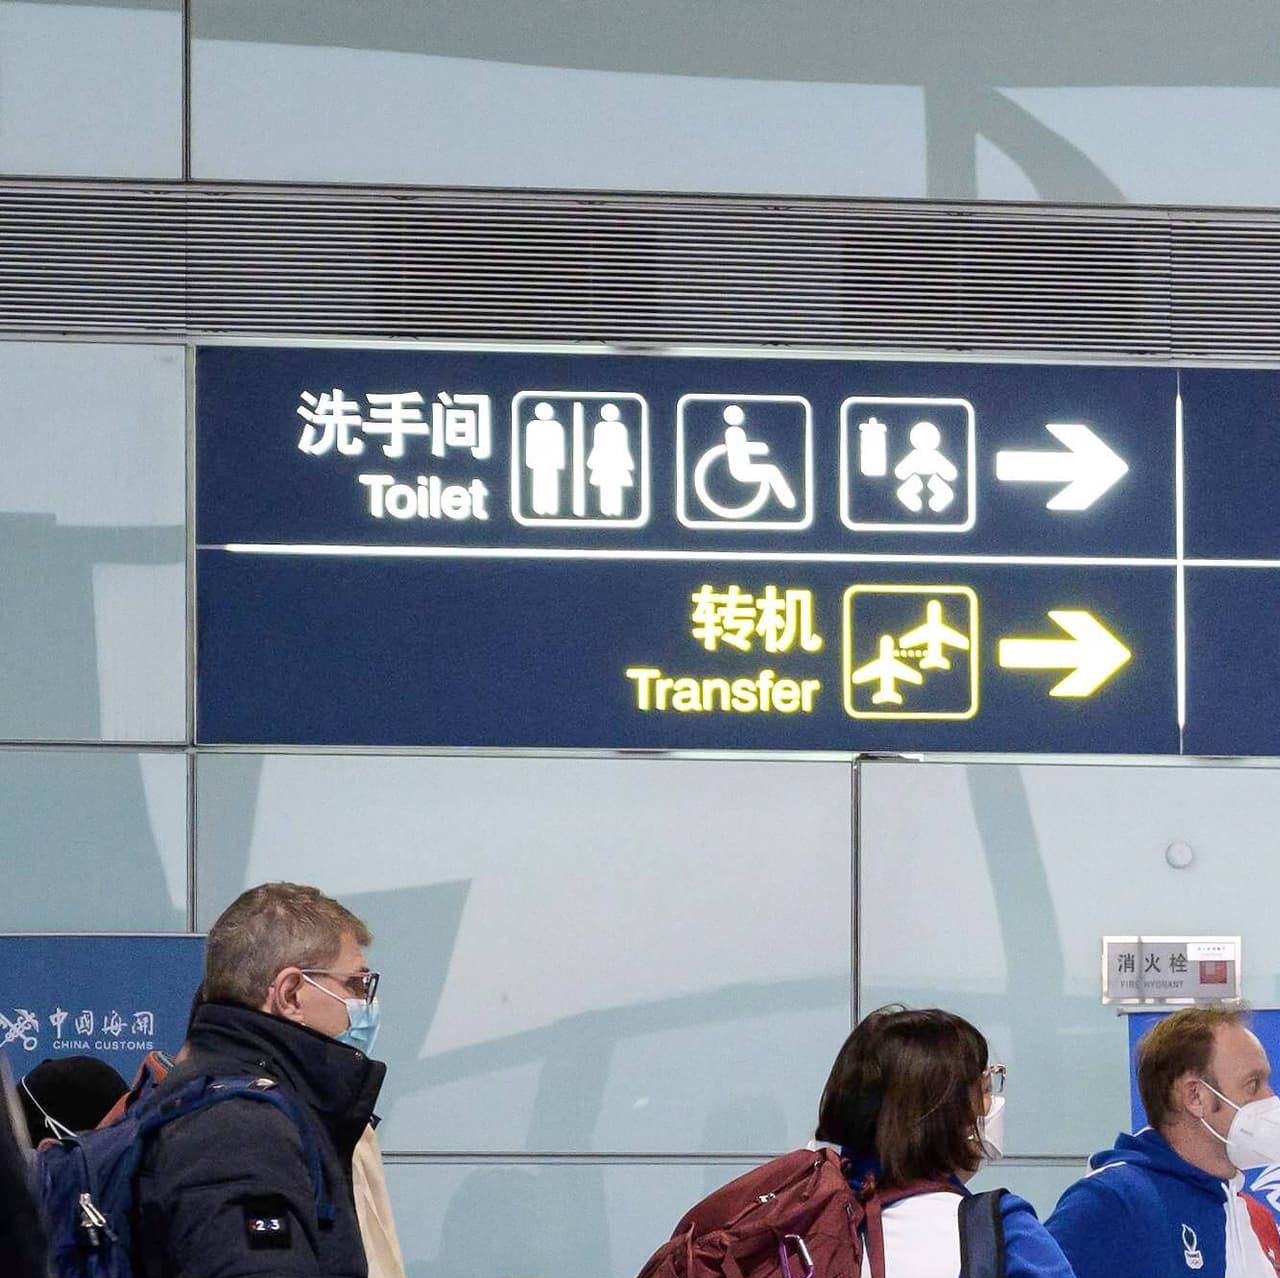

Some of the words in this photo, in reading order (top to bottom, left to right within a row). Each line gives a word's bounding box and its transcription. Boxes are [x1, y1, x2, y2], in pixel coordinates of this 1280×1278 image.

[296, 389, 491, 460] 洗手间
[360, 474, 488, 520] Toilet
[690, 585, 823, 655] 转机
[626, 668, 821, 715] Transfer
[1117, 953, 1188, 973] 消火栓
[53, 1041, 89, 1050] CHINA
[95, 1041, 153, 1050] CUSTOMS
